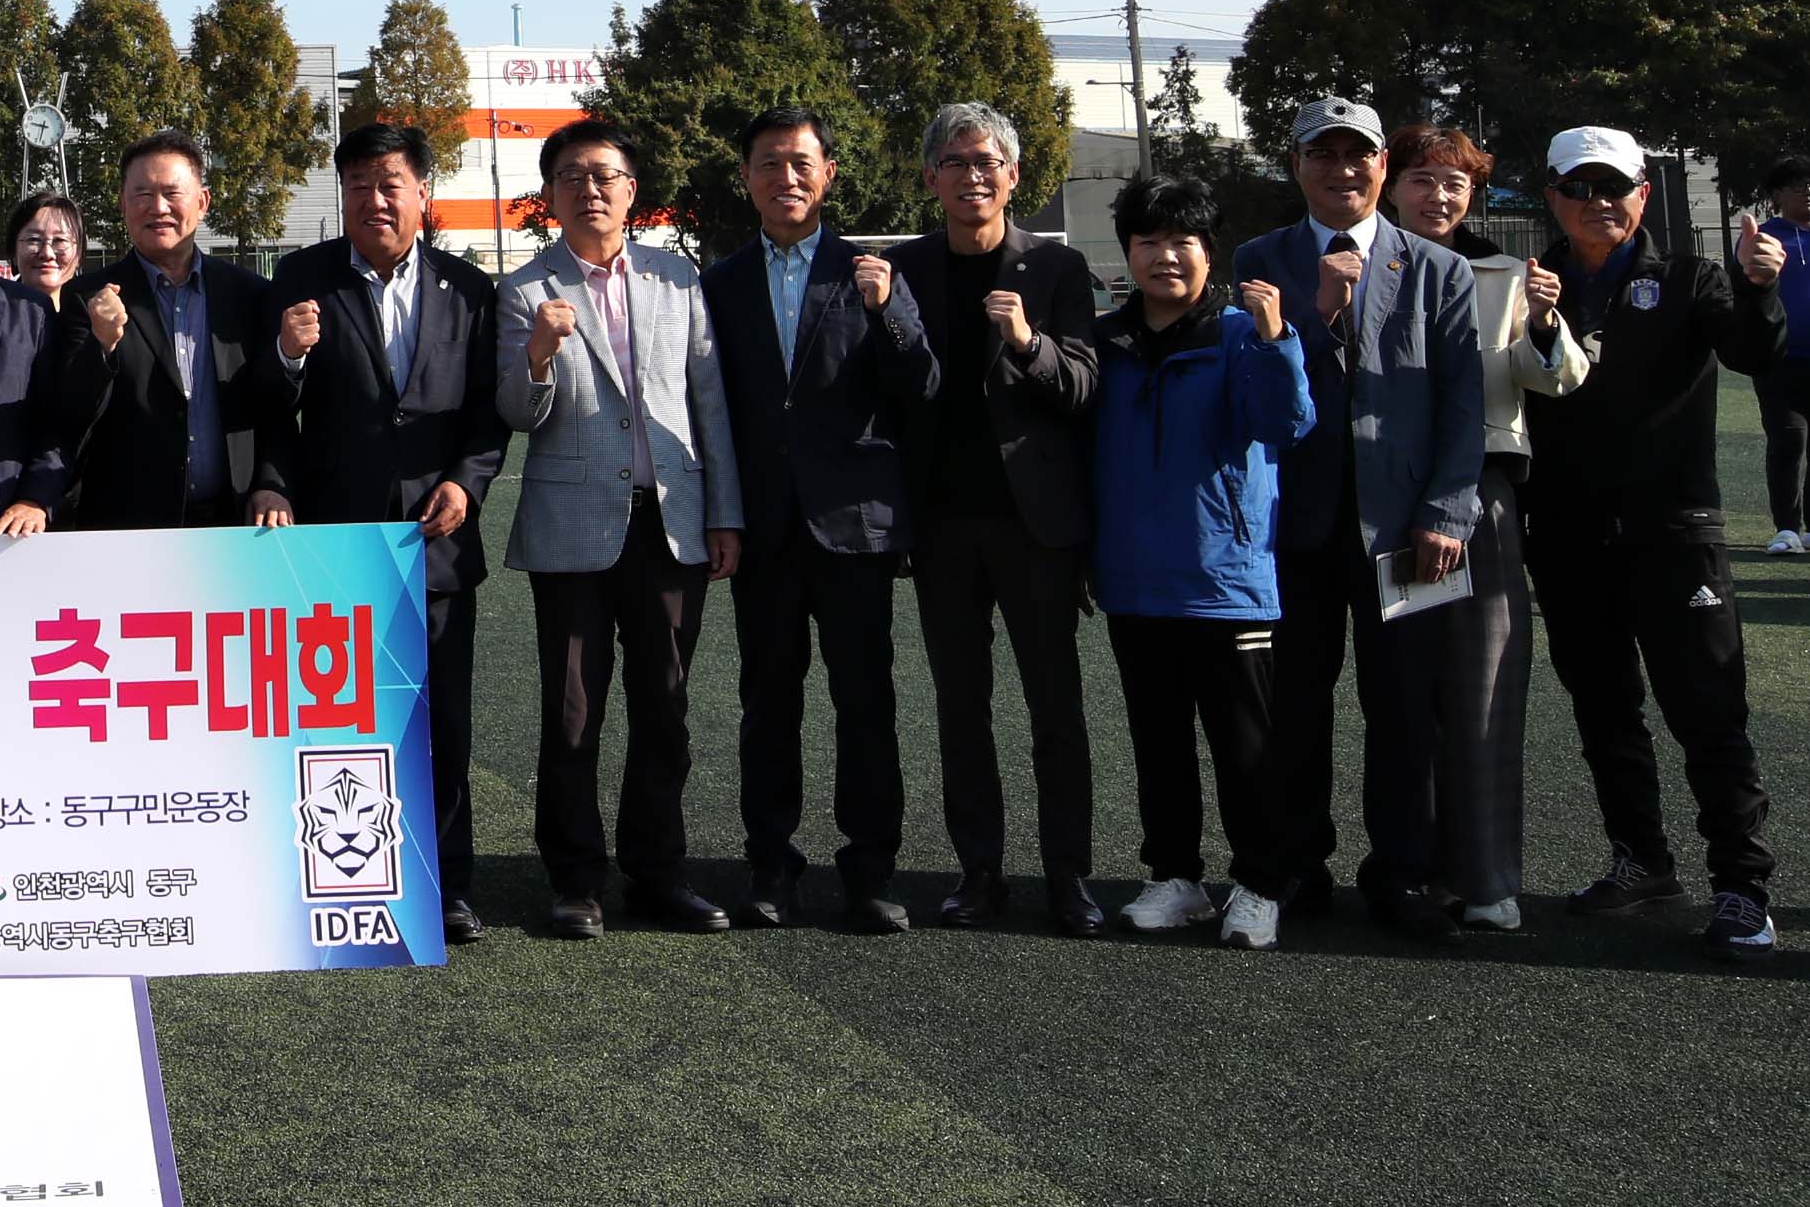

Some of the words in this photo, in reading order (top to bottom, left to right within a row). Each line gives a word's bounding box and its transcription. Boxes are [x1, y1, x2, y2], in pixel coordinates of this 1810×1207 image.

[1689, 596, 1723, 608] adidas
[28, 603, 376, 743] 축구대회
[61, 789, 252, 828] 동구구민운동장
[12, 869, 135, 902] 인천광역시
[145, 867, 198, 898] 동구
[312, 907, 397, 944] IDFA
